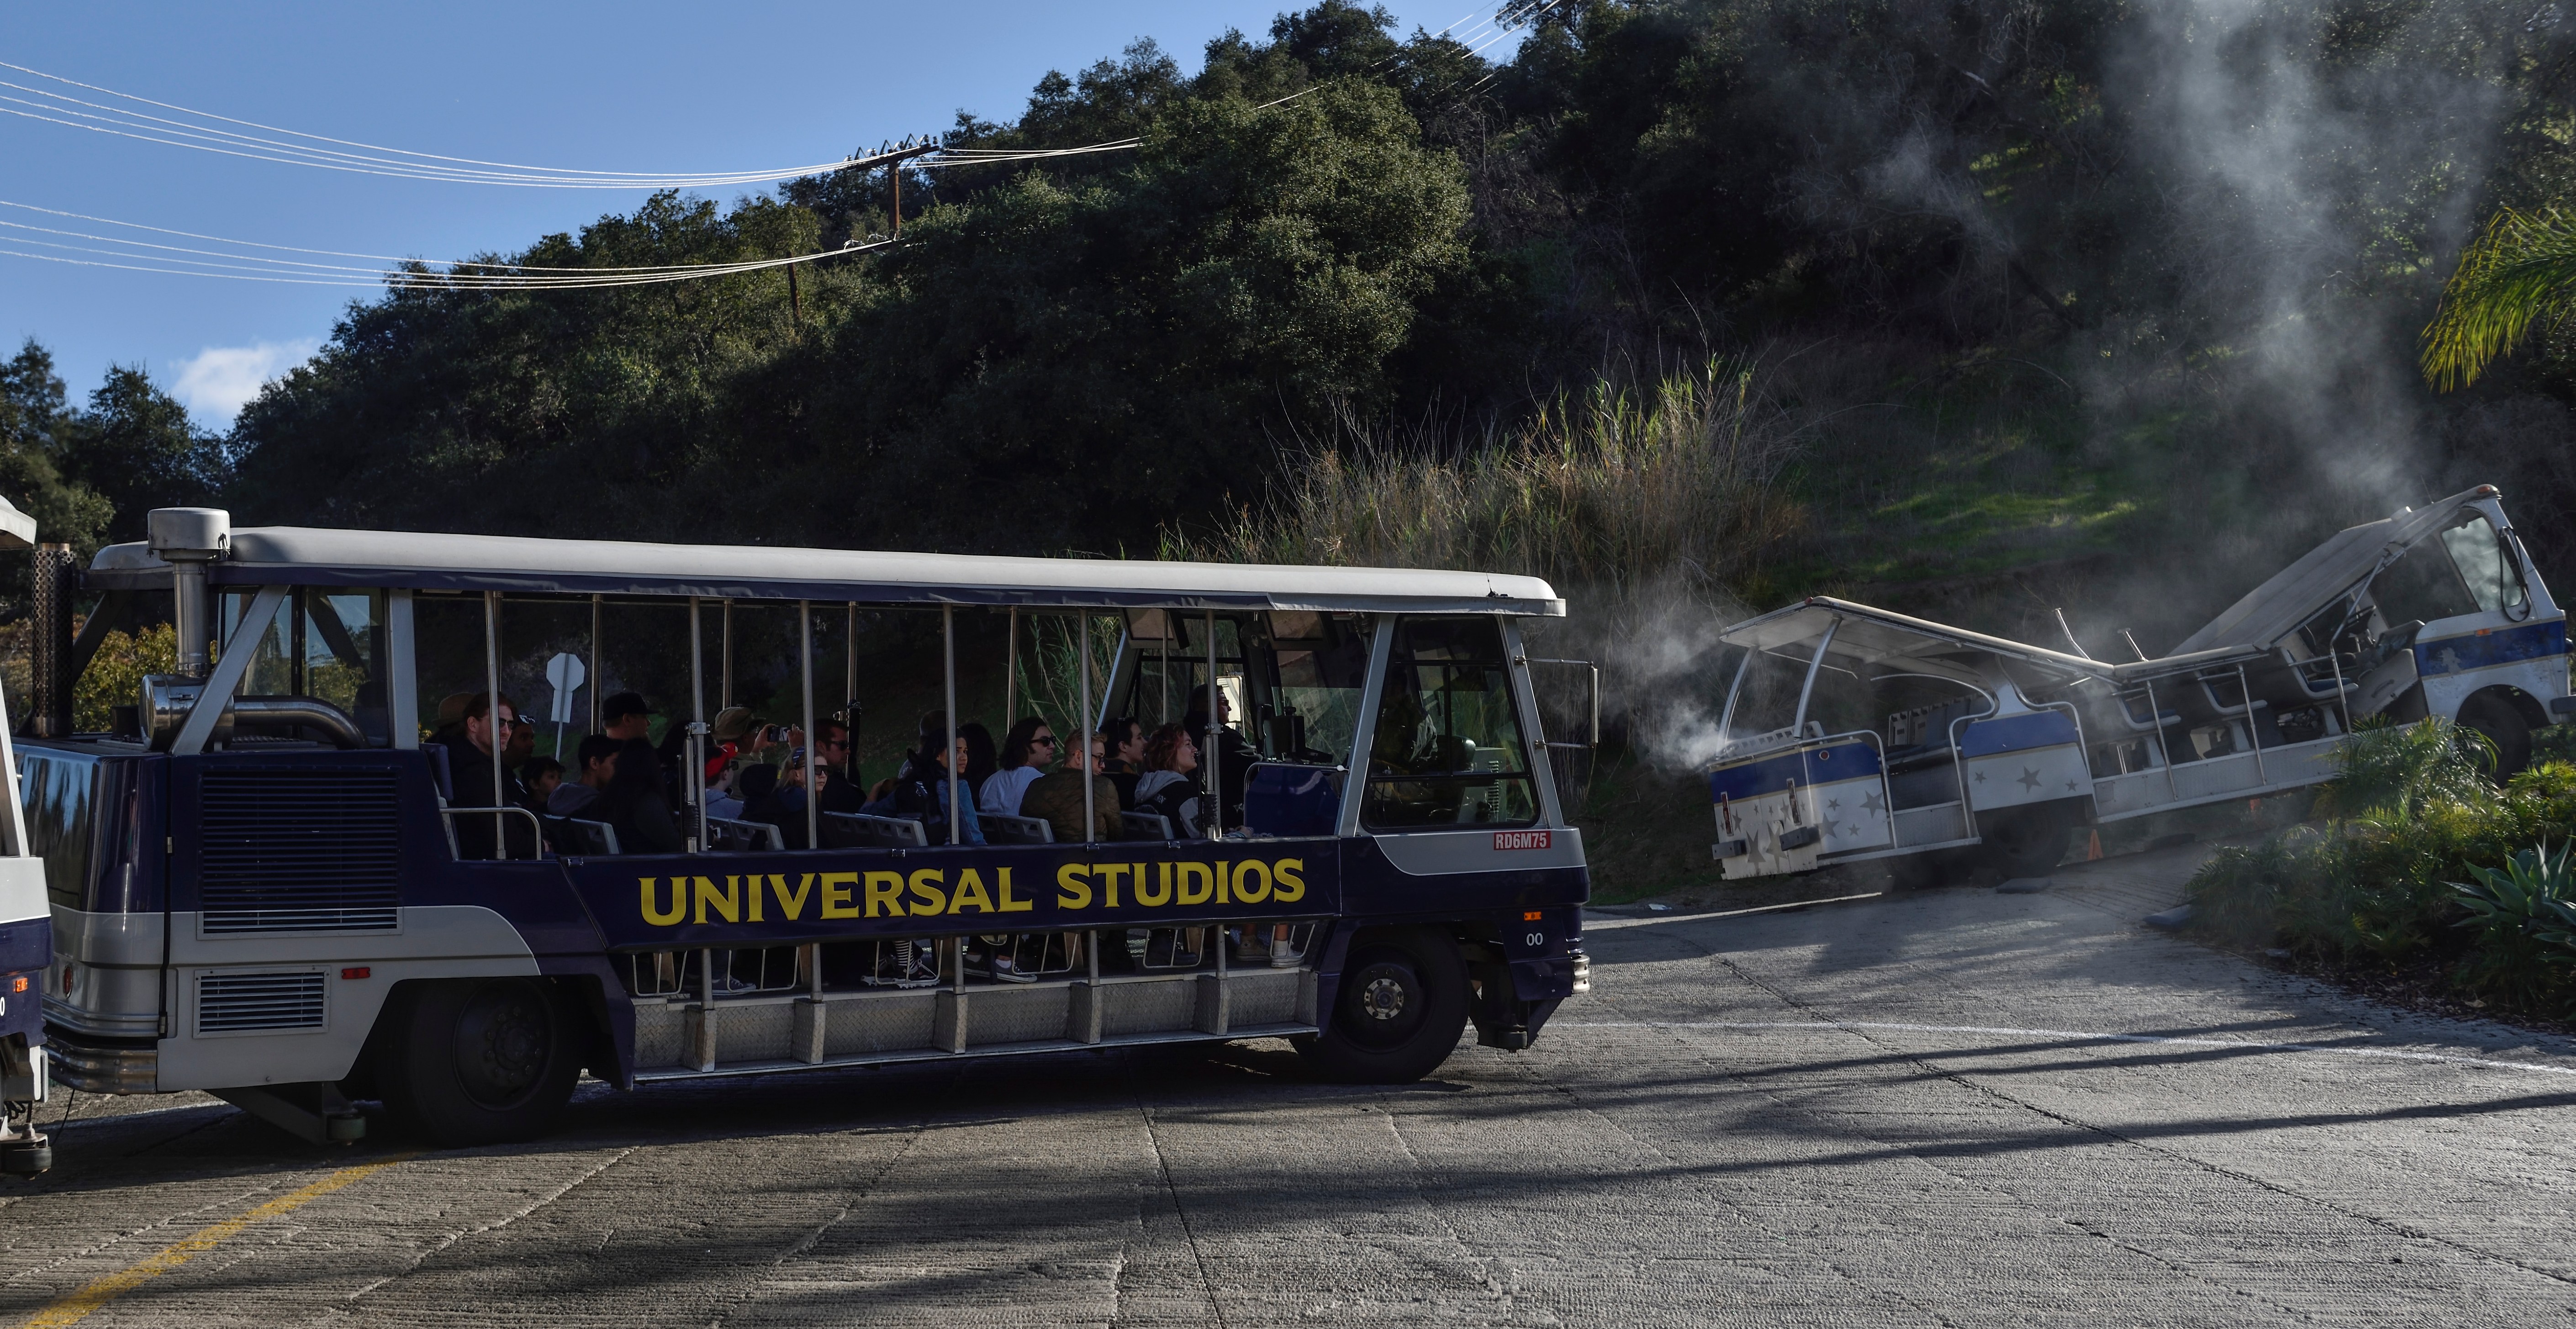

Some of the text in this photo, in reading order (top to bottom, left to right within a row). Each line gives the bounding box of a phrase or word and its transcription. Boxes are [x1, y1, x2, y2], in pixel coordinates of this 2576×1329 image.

[1495, 833, 1547, 849] RD6M75
[639, 858, 1305, 926] UNIVERSAL STUDIOS
[1526, 933, 1543, 946] 00
